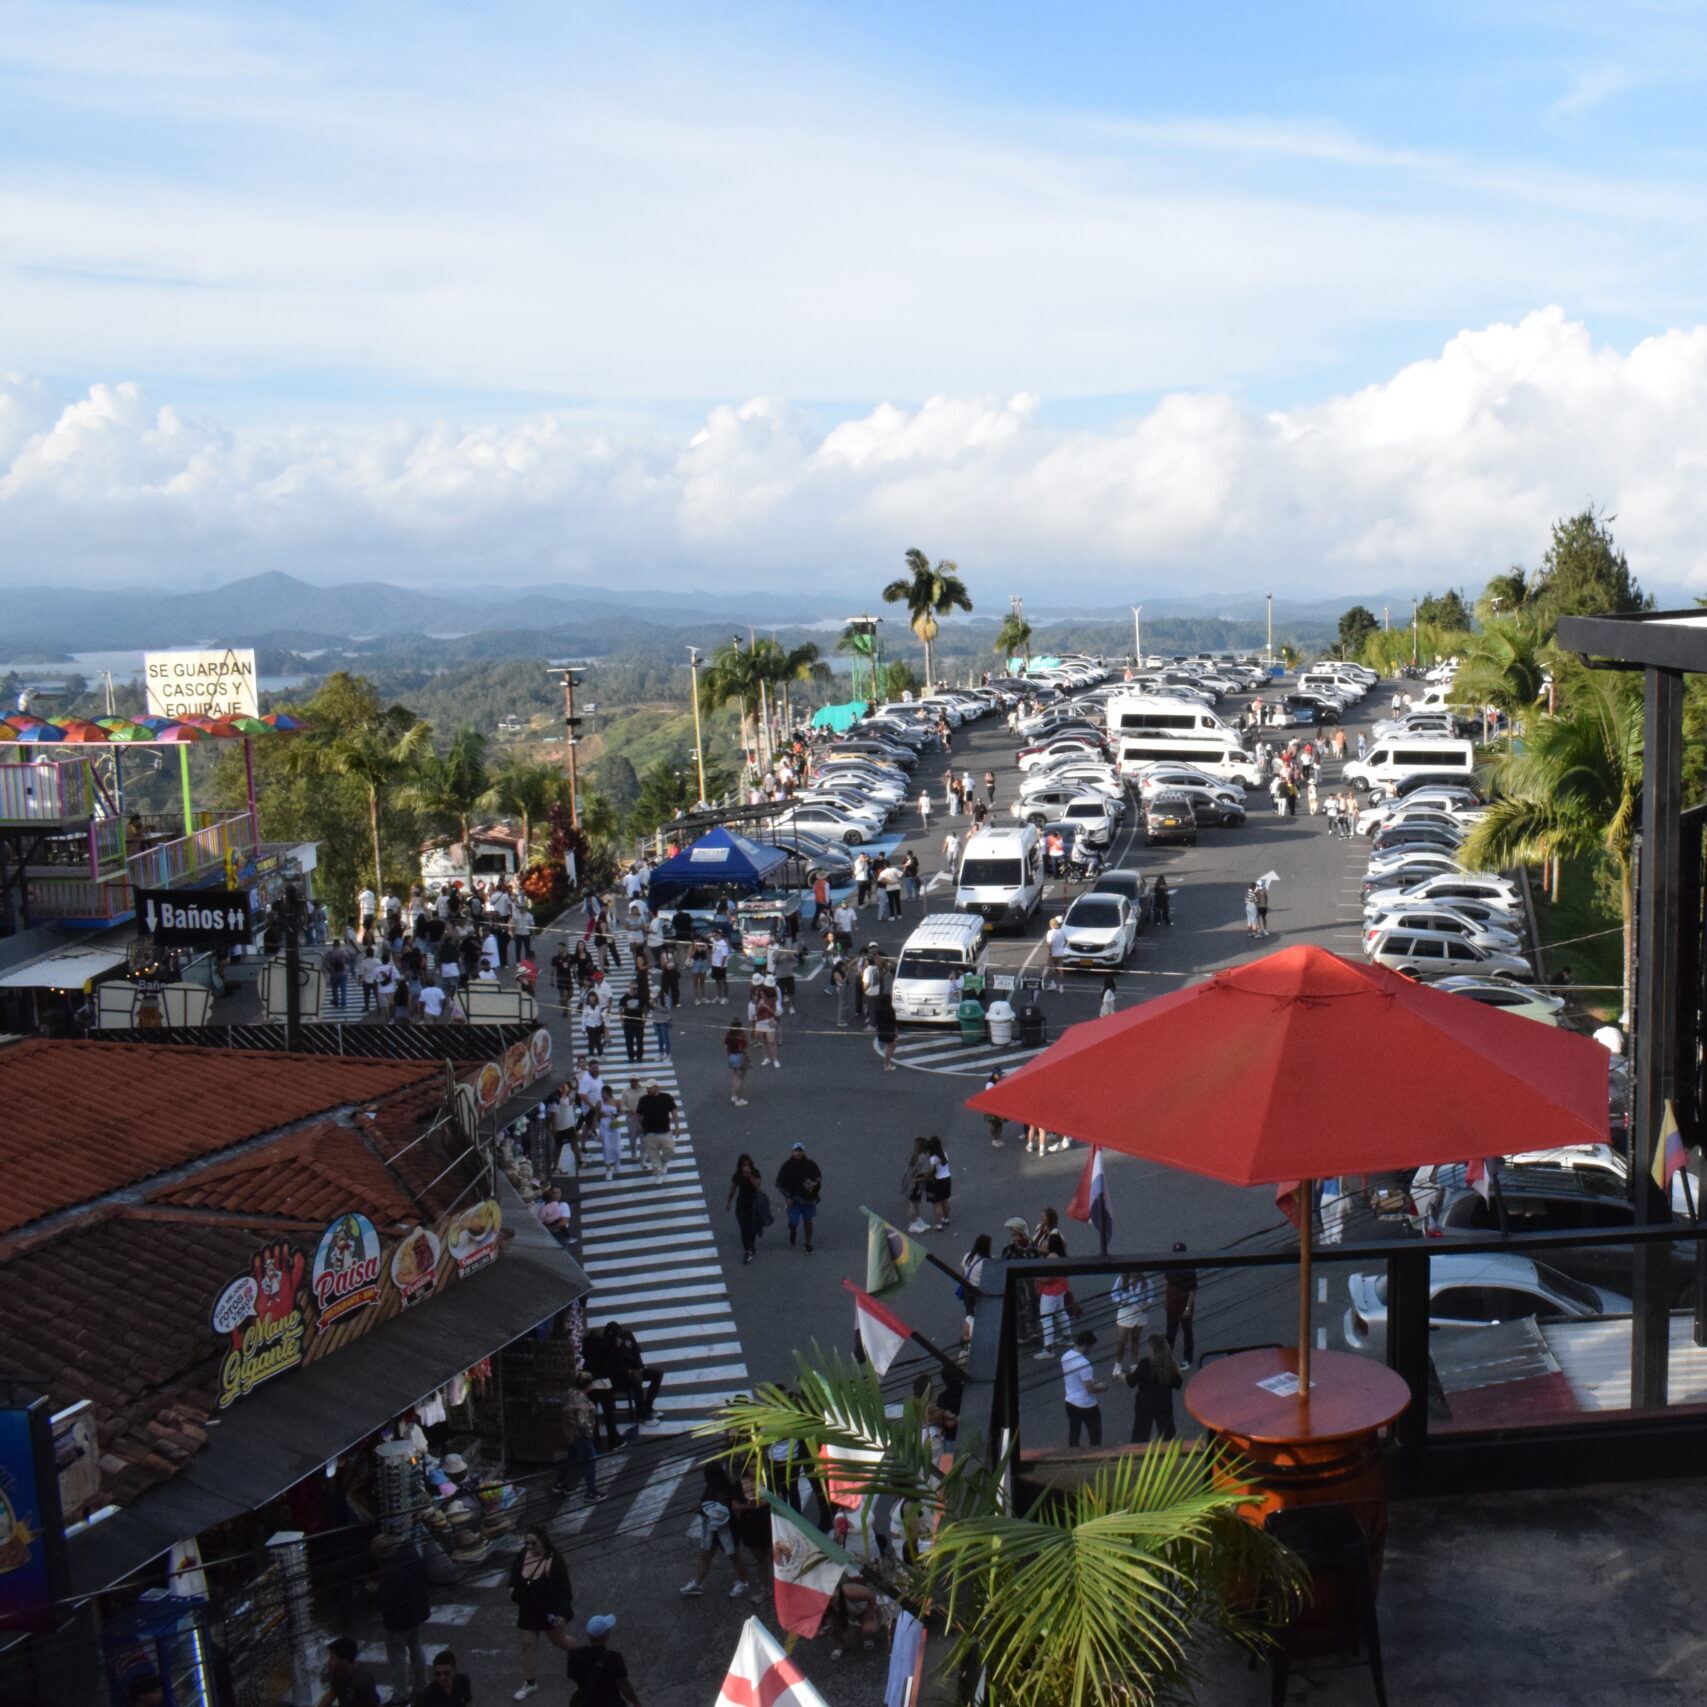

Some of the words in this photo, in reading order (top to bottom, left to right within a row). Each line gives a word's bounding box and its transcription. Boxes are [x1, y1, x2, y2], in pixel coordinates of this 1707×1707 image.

[149, 664, 168, 677] SE
[174, 661, 252, 676] GUARDAN
[163, 682, 227, 697] CASCOS
[232, 682, 242, 695] Y
[166, 702, 242, 717] EQUIPAJE
[161, 903, 224, 929] Baños
[316, 1256, 378, 1307] Paisa
[219, 1294, 243, 1326] FOTOS
[243, 1311, 301, 1355] Mano
[219, 1334, 300, 1406] Gigante
